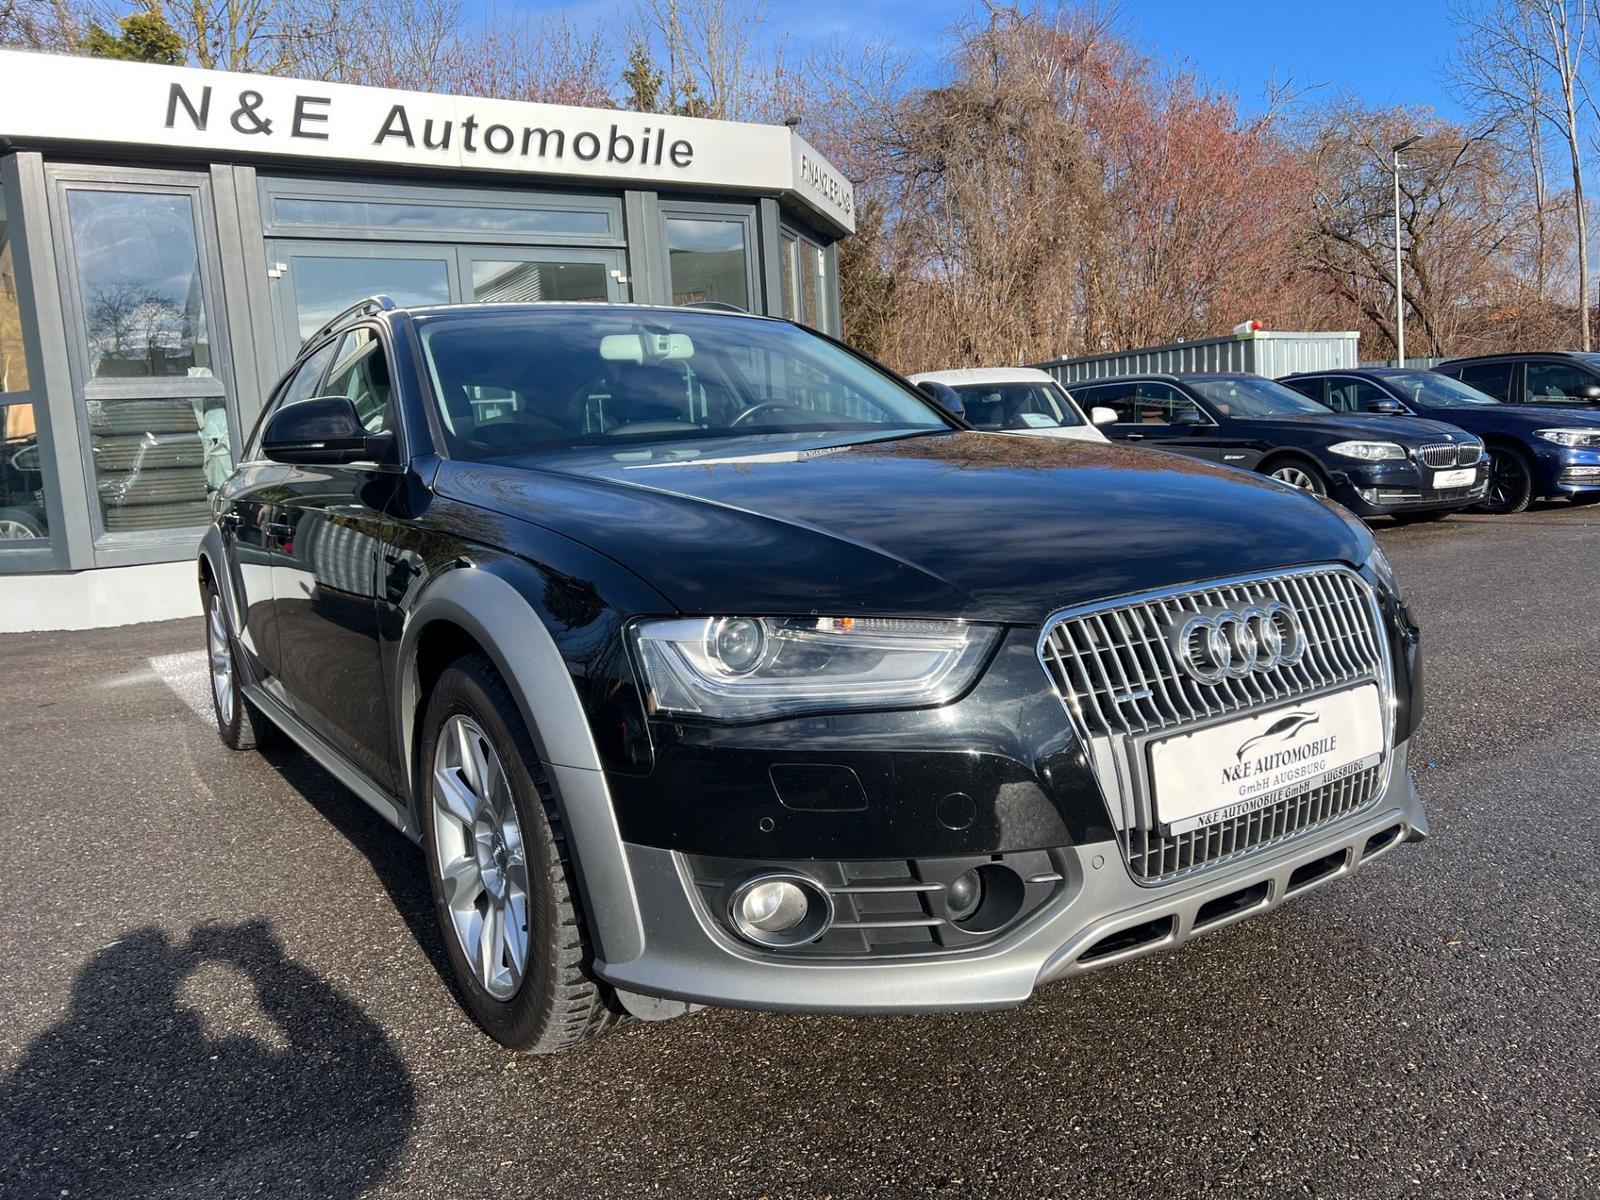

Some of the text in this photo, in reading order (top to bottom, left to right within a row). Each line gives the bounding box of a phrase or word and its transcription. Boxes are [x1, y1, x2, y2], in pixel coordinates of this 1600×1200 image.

[371, 104, 695, 168] Automobile
[1221, 735, 1337, 785] N&E AUTOMOBILE
[1239, 760, 1327, 796] GmbH AUGSBURG
[1197, 760, 1364, 828] N&E AUTOMOBILE GmbH AUGSBURG
